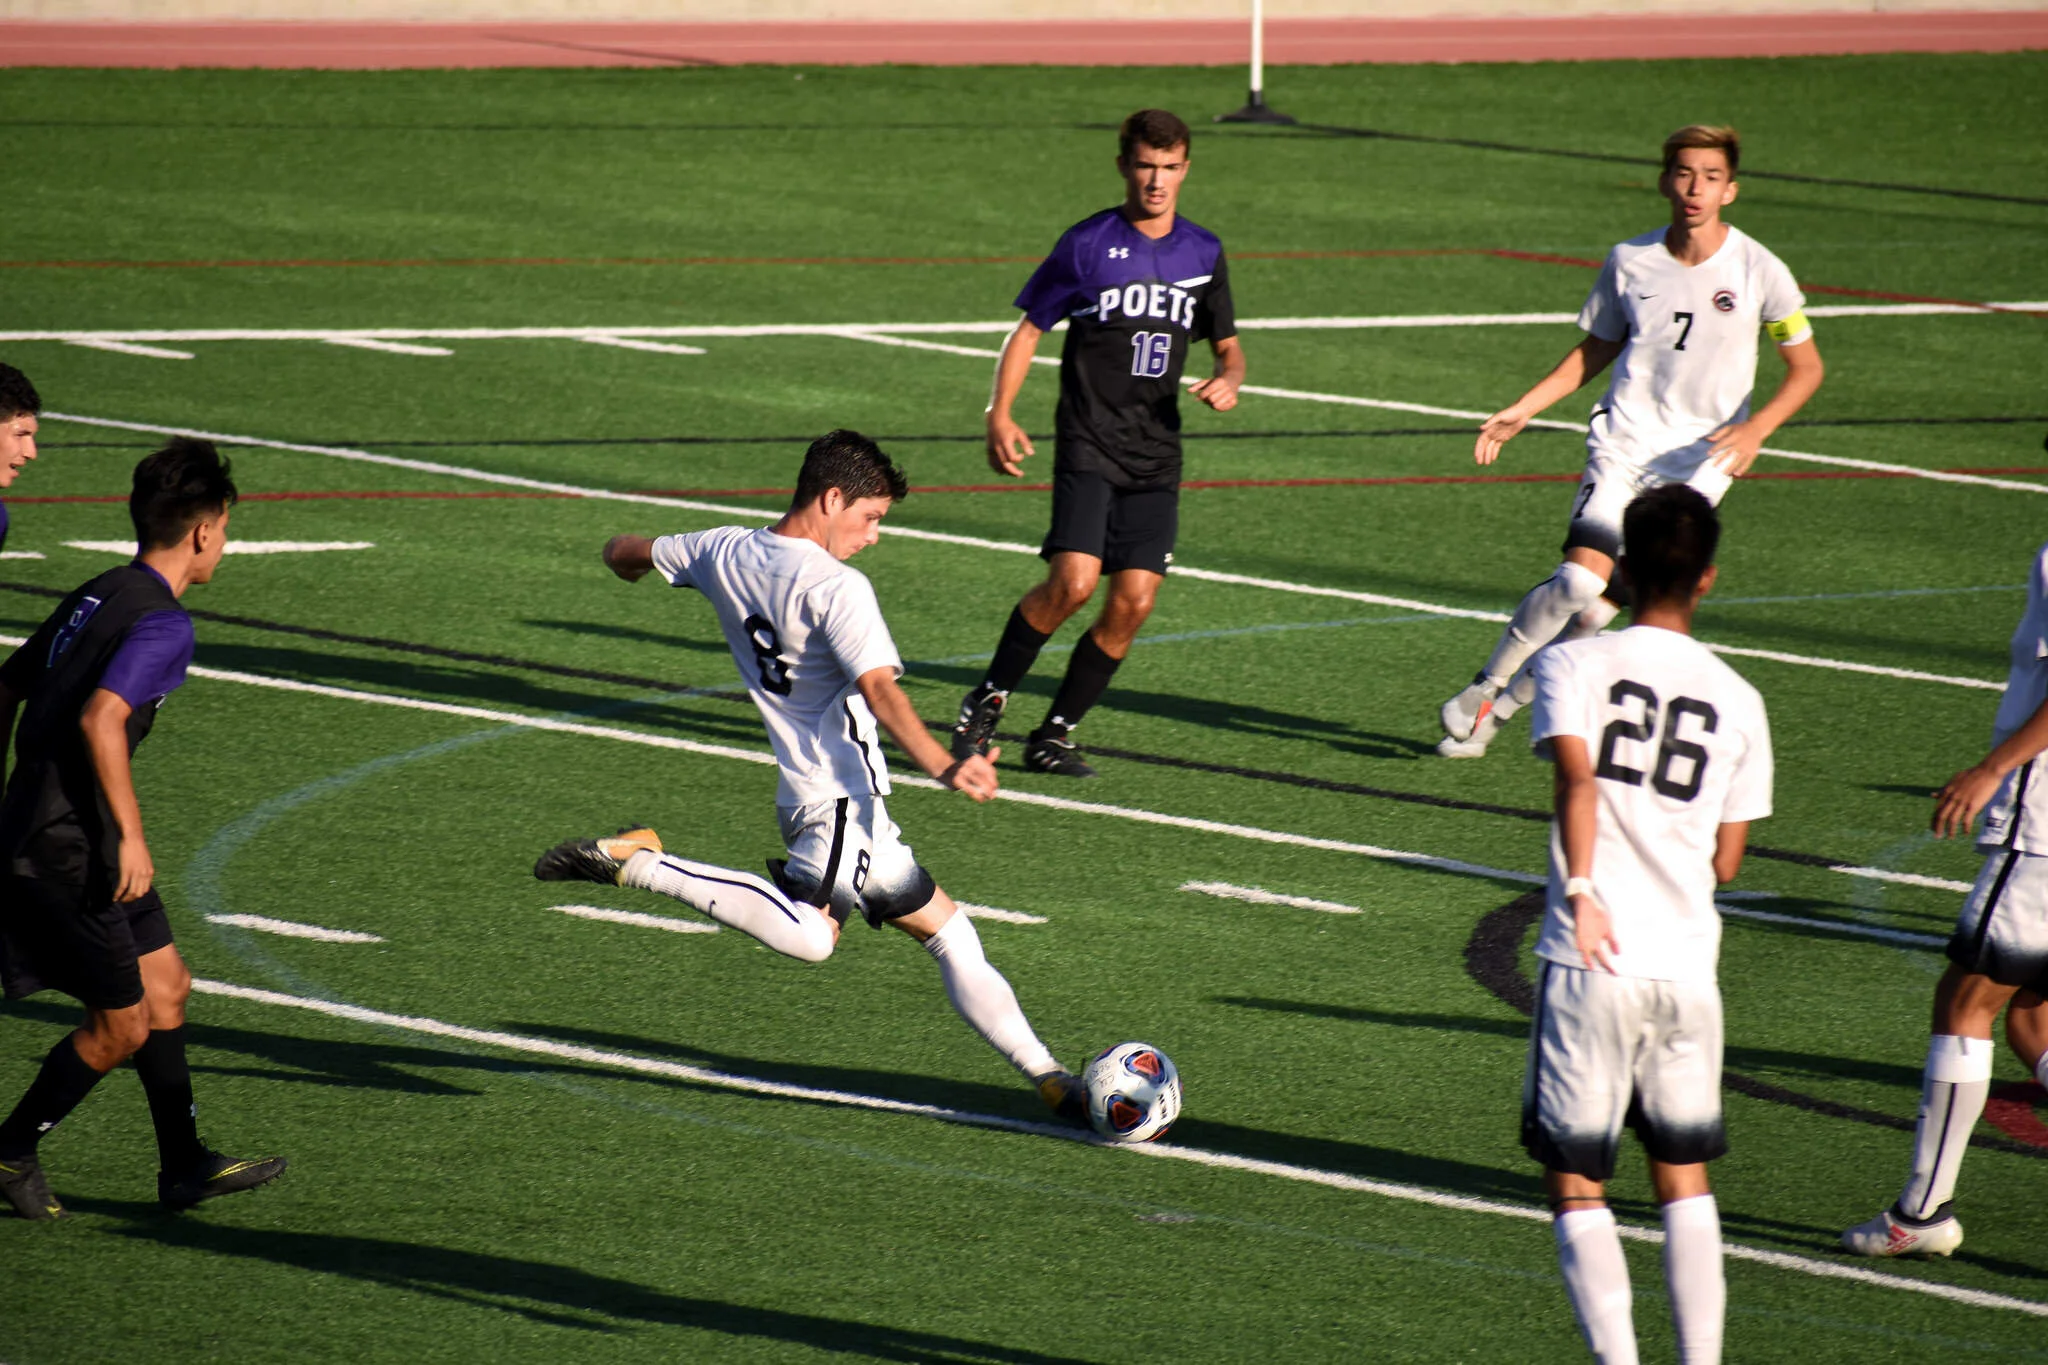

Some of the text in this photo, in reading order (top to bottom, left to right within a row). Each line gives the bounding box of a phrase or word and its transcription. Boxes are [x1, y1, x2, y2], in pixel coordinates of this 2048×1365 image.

[1099, 284, 1197, 329] POETS
[1674, 312, 1693, 351] 7
[1131, 331, 1173, 378] 16
[1573, 483, 1596, 519] 7
[744, 613, 792, 697] 8
[1595, 679, 1719, 802] 26
[852, 849, 871, 894] 8
